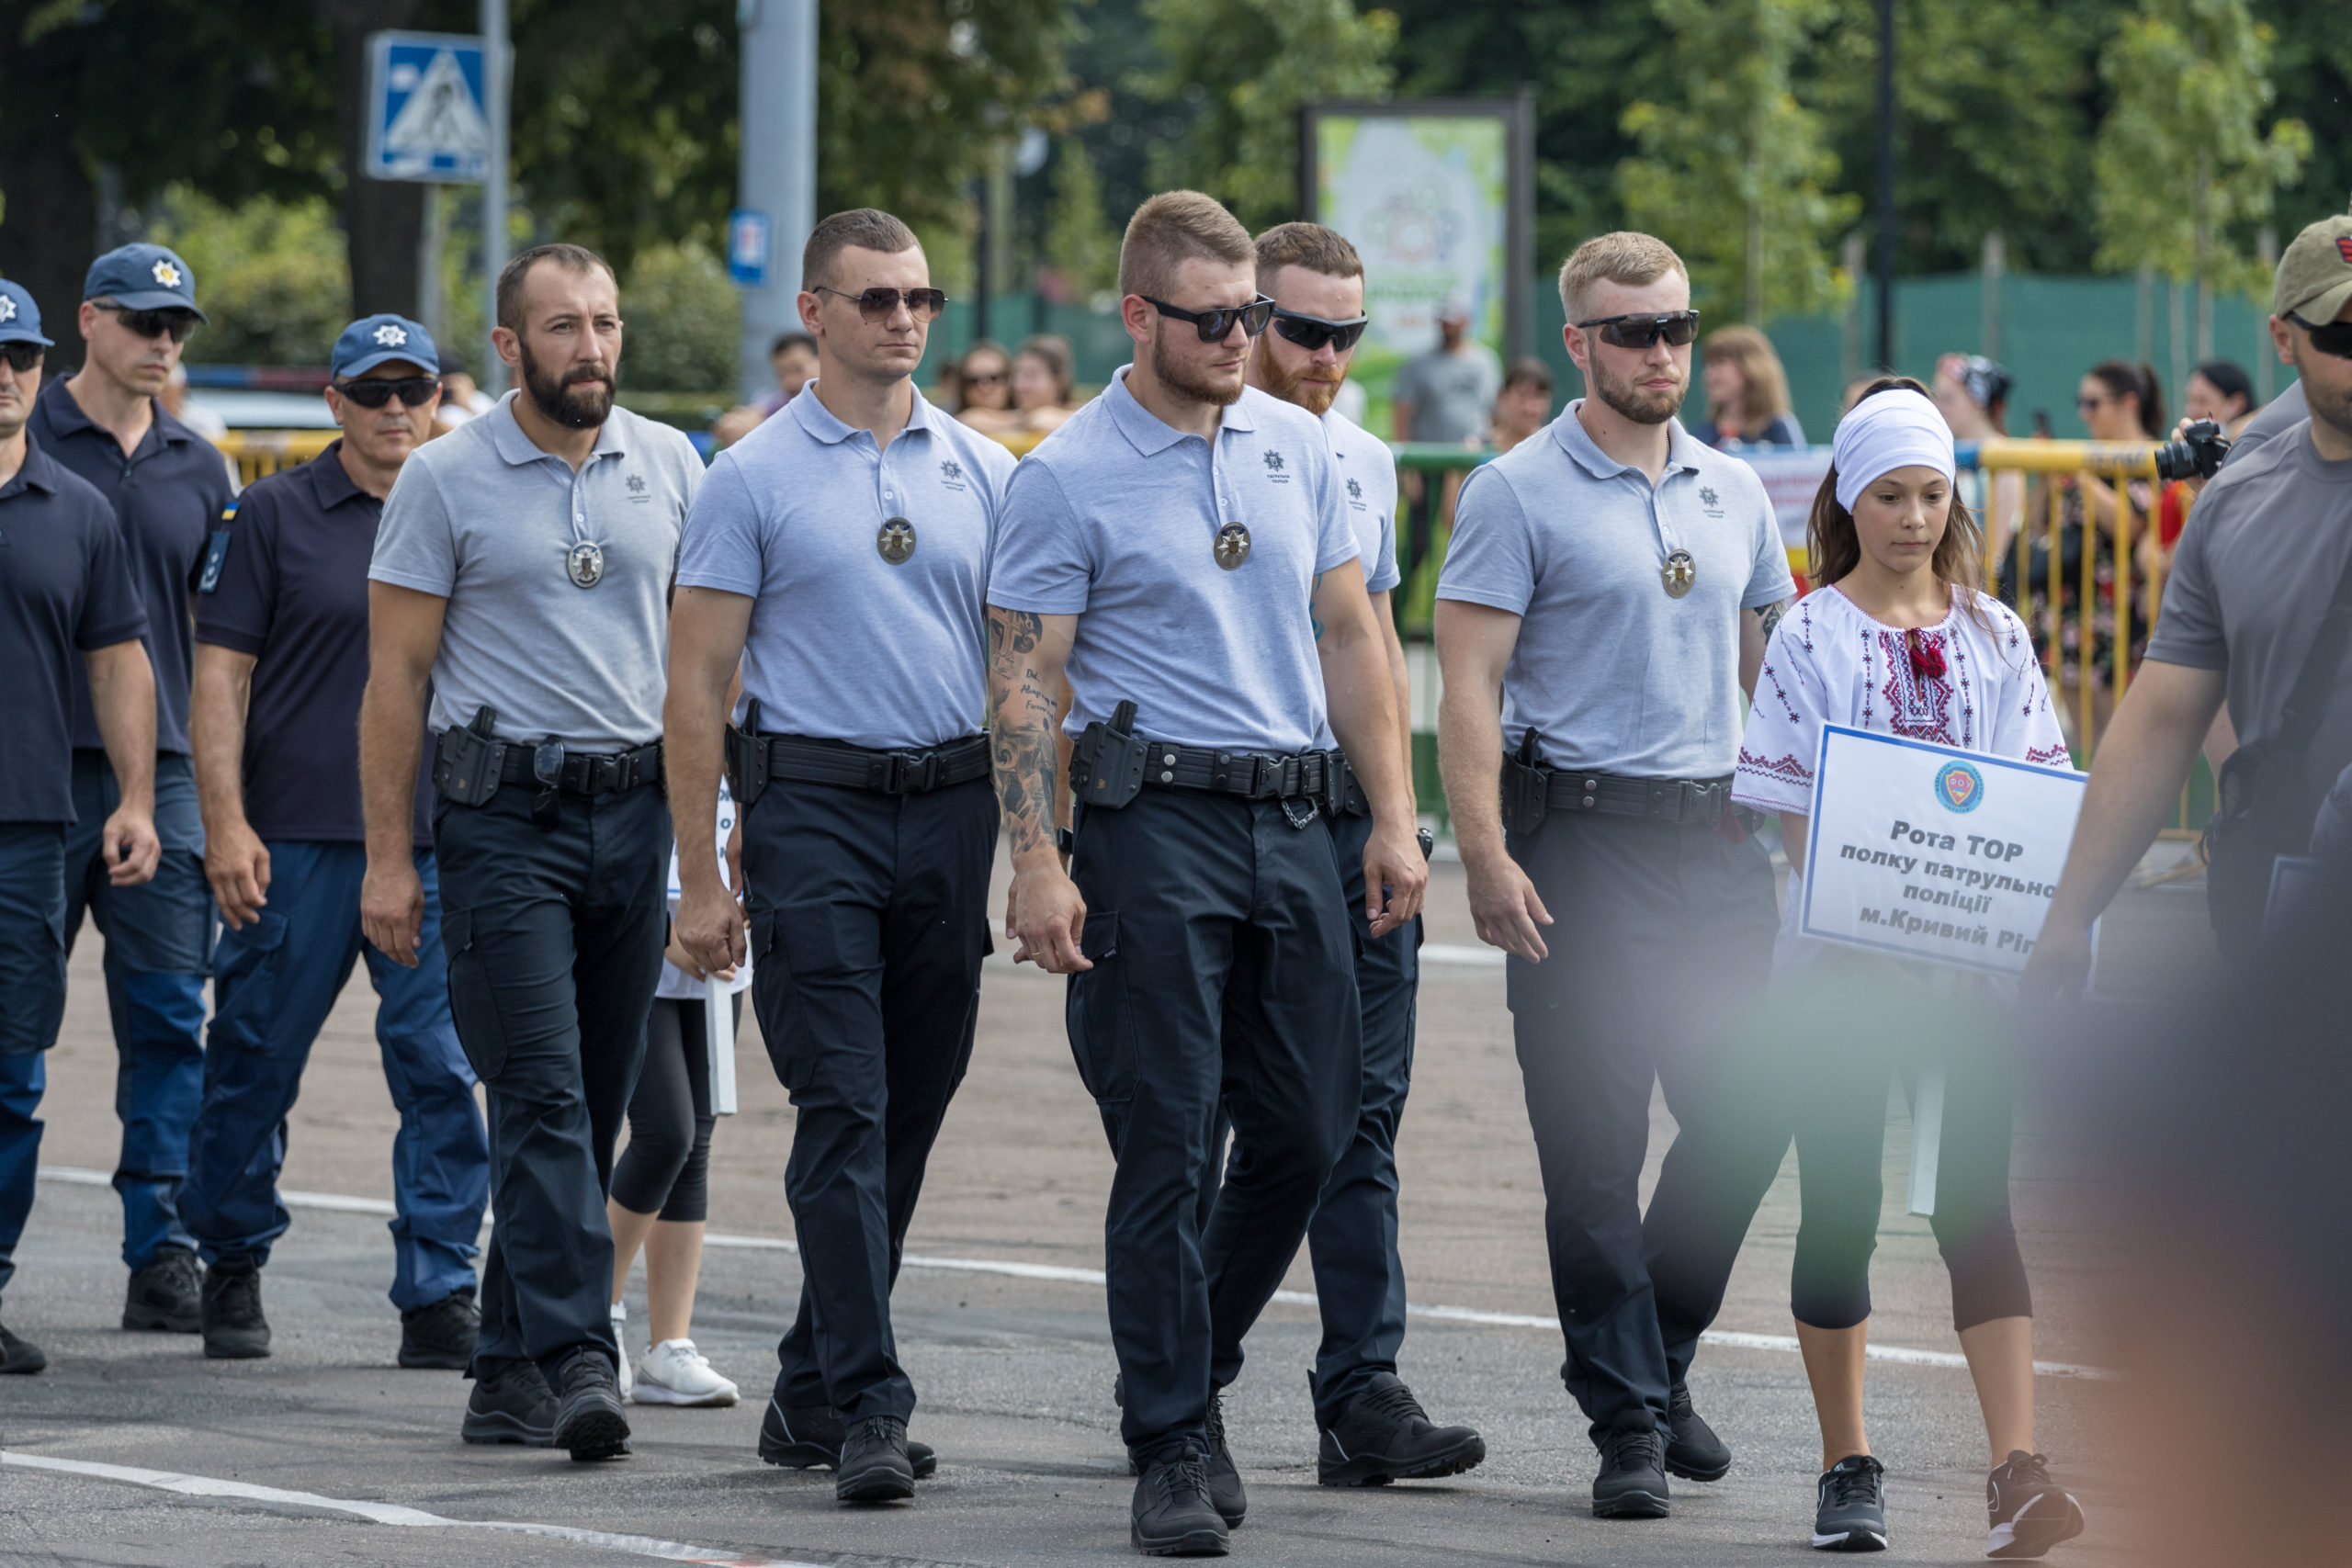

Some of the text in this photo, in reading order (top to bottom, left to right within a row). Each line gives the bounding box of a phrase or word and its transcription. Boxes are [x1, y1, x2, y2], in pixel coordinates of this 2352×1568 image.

[1890, 820, 2024, 863] Рота ТОР
[1840, 844, 2057, 898] полку патрульно
[1903, 885, 1993, 914] поліції
[1996, 929, 2037, 954] Ріг
